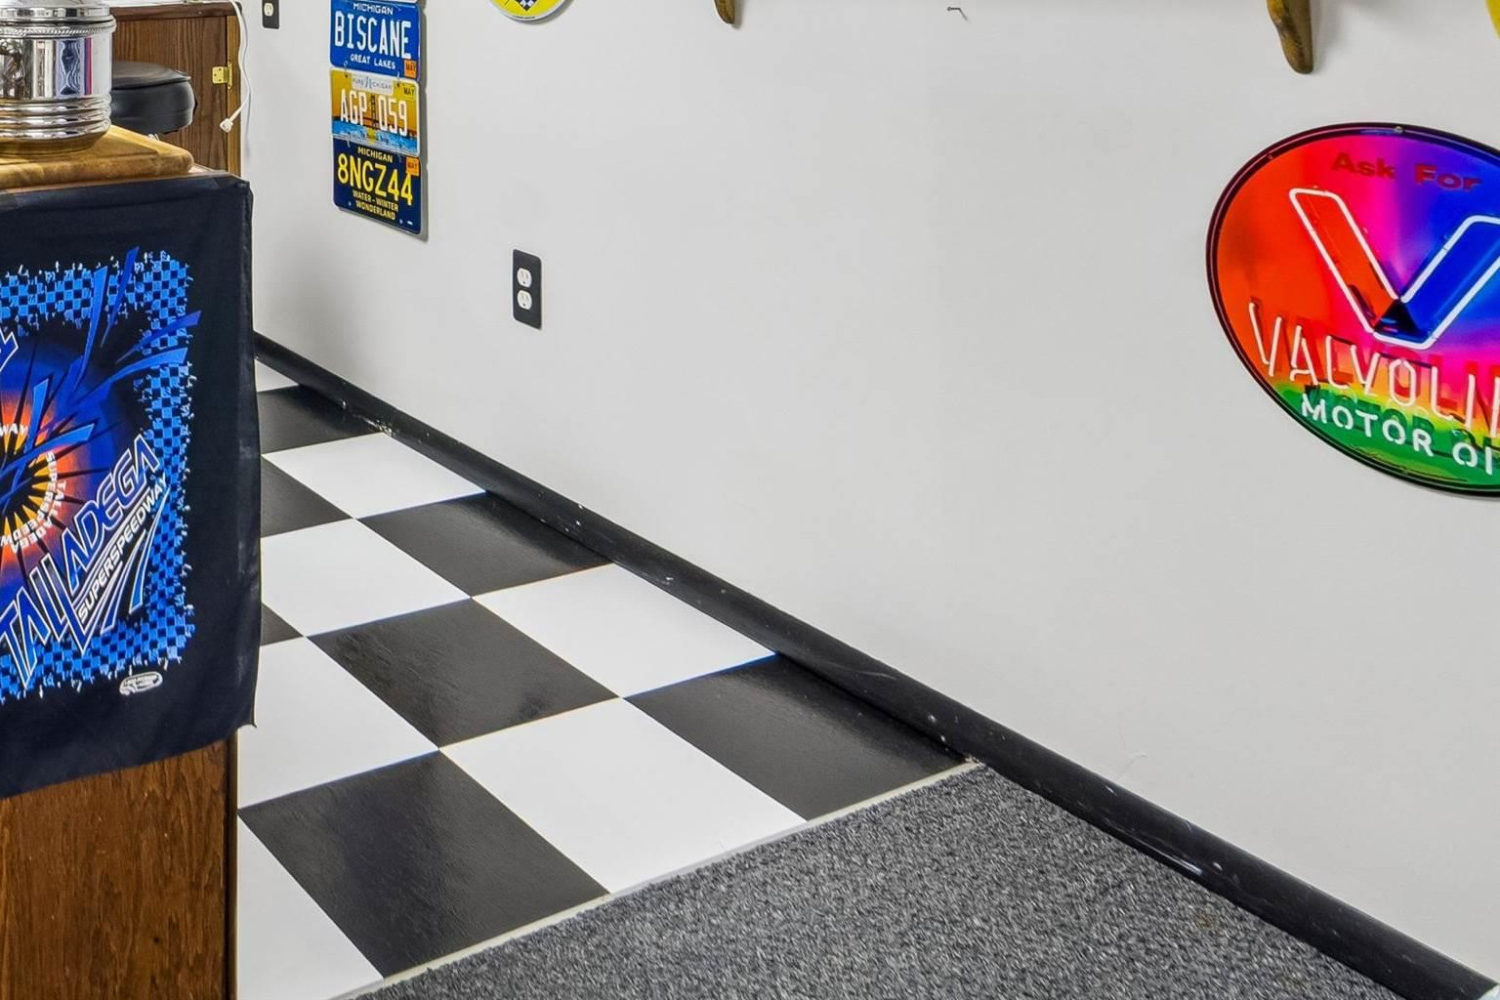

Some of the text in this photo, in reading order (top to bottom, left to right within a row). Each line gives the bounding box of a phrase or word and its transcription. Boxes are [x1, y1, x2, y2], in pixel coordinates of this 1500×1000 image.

[353, 3, 394, 15] MICHIGAN
[335, 10, 411, 59] BISCANE
[350, 53, 396, 69] GREAT LAKES
[341, 88, 408, 136] AGP 059
[404, 87, 415, 96] MAY
[357, 146, 394, 163] MICHIGAN
[1331, 152, 1483, 192] Ask For
[337, 153, 413, 206] 8NGZ44
[355, 200, 396, 220] WONDERLAND
[1248, 301, 1500, 438] VALVOLI
[1301, 393, 1434, 458] MOTOR
[10, 480, 66, 554] TALLADEGA
[78, 472, 168, 623] SUPERSPEEDWAY
